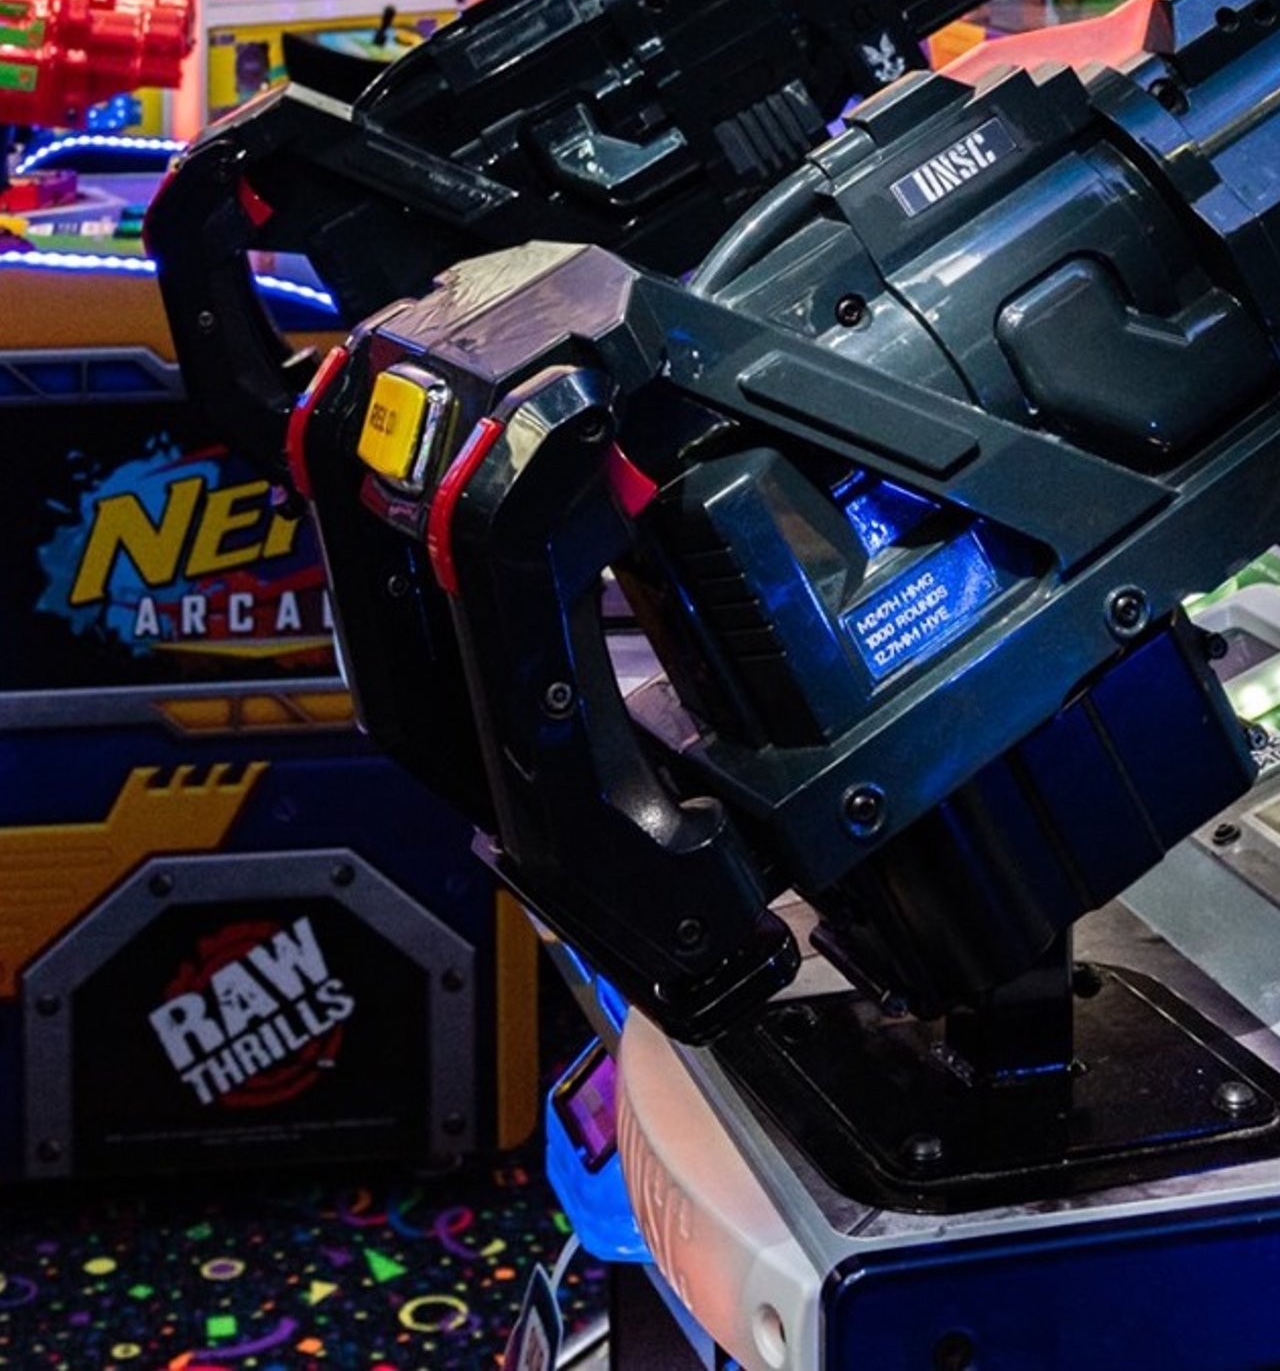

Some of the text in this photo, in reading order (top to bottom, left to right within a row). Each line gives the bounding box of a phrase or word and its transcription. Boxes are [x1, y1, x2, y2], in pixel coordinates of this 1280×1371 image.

[912, 131, 997, 203] UNSC
[70, 477, 299, 606] NE
[134, 589, 335, 635] ARCA
[895, 584, 948, 628] ROUNDS
[901, 572, 934, 603] HMG
[148, 915, 329, 1072] RAW
[181, 979, 355, 1105] THRILLS
